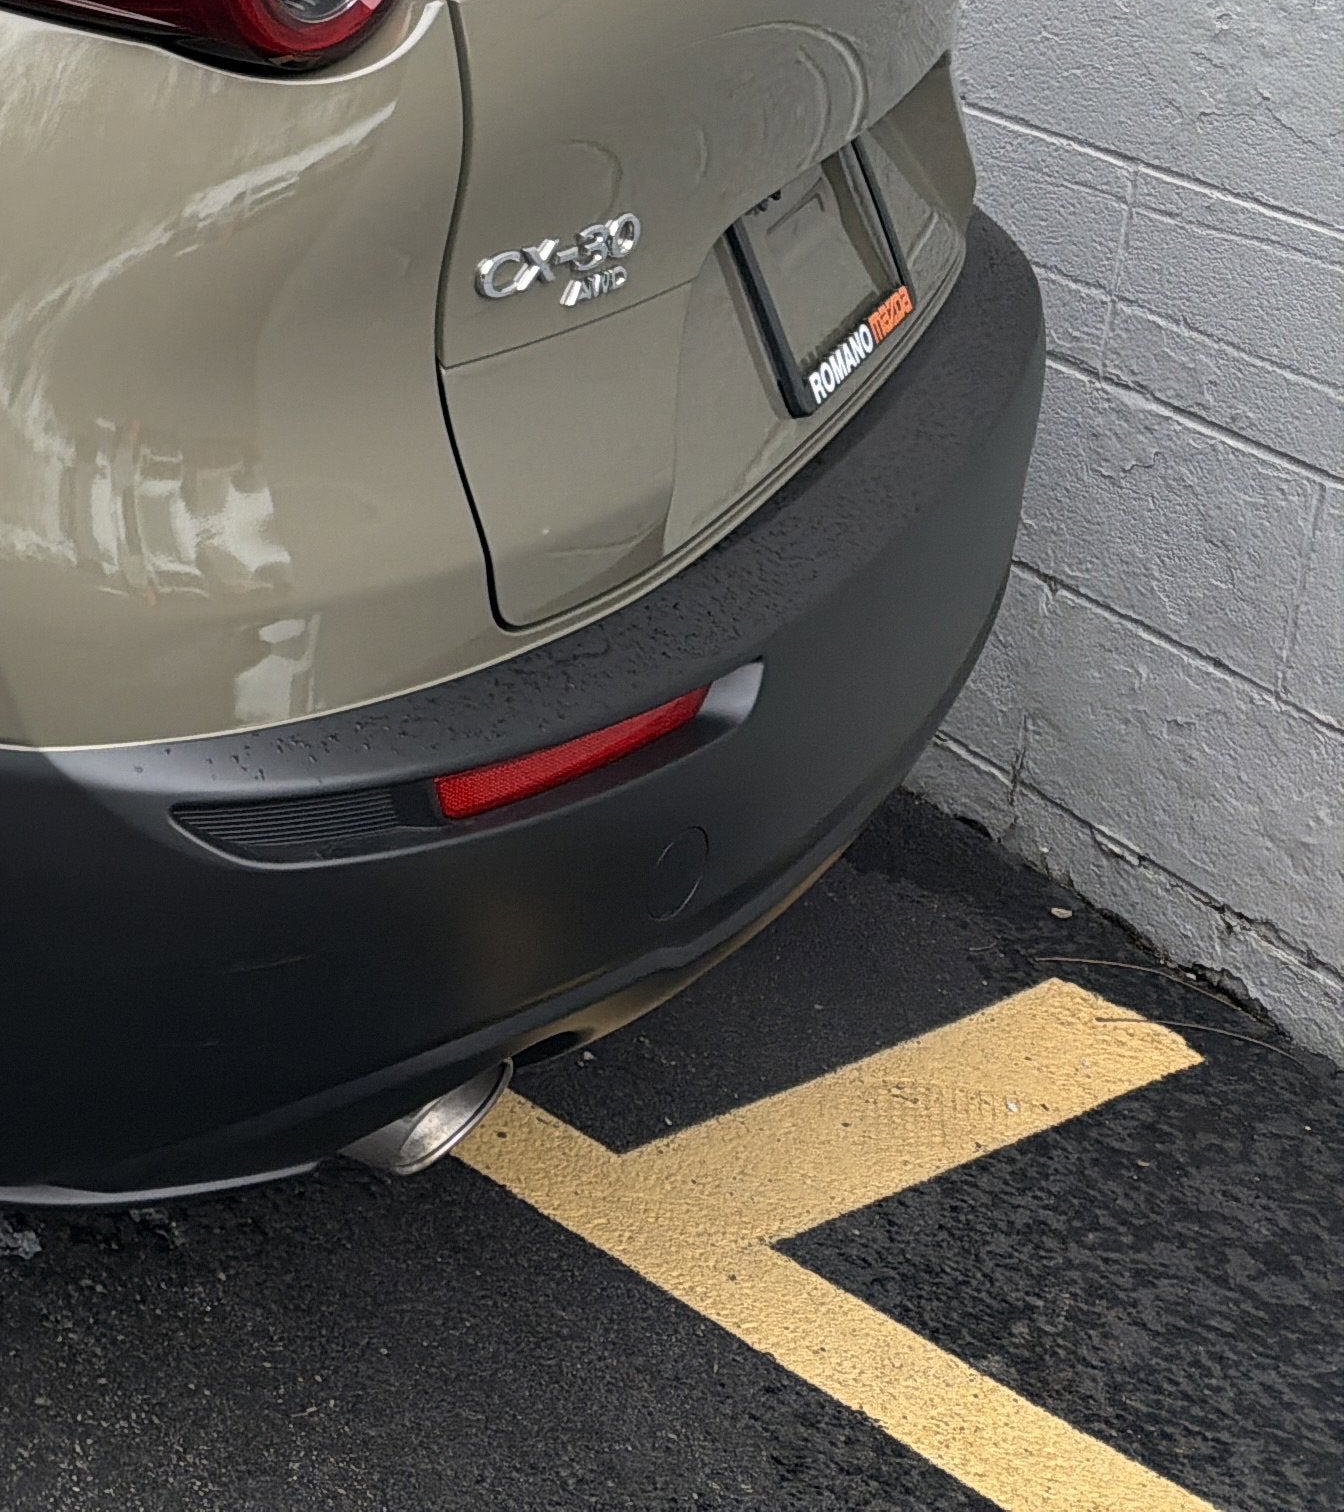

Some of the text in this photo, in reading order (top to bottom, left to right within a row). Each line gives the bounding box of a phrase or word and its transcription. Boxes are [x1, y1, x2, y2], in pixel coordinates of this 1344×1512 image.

[475, 213, 641, 298] CX-30
[560, 265, 628, 307] AWD
[808, 323, 874, 405] ROMANO
